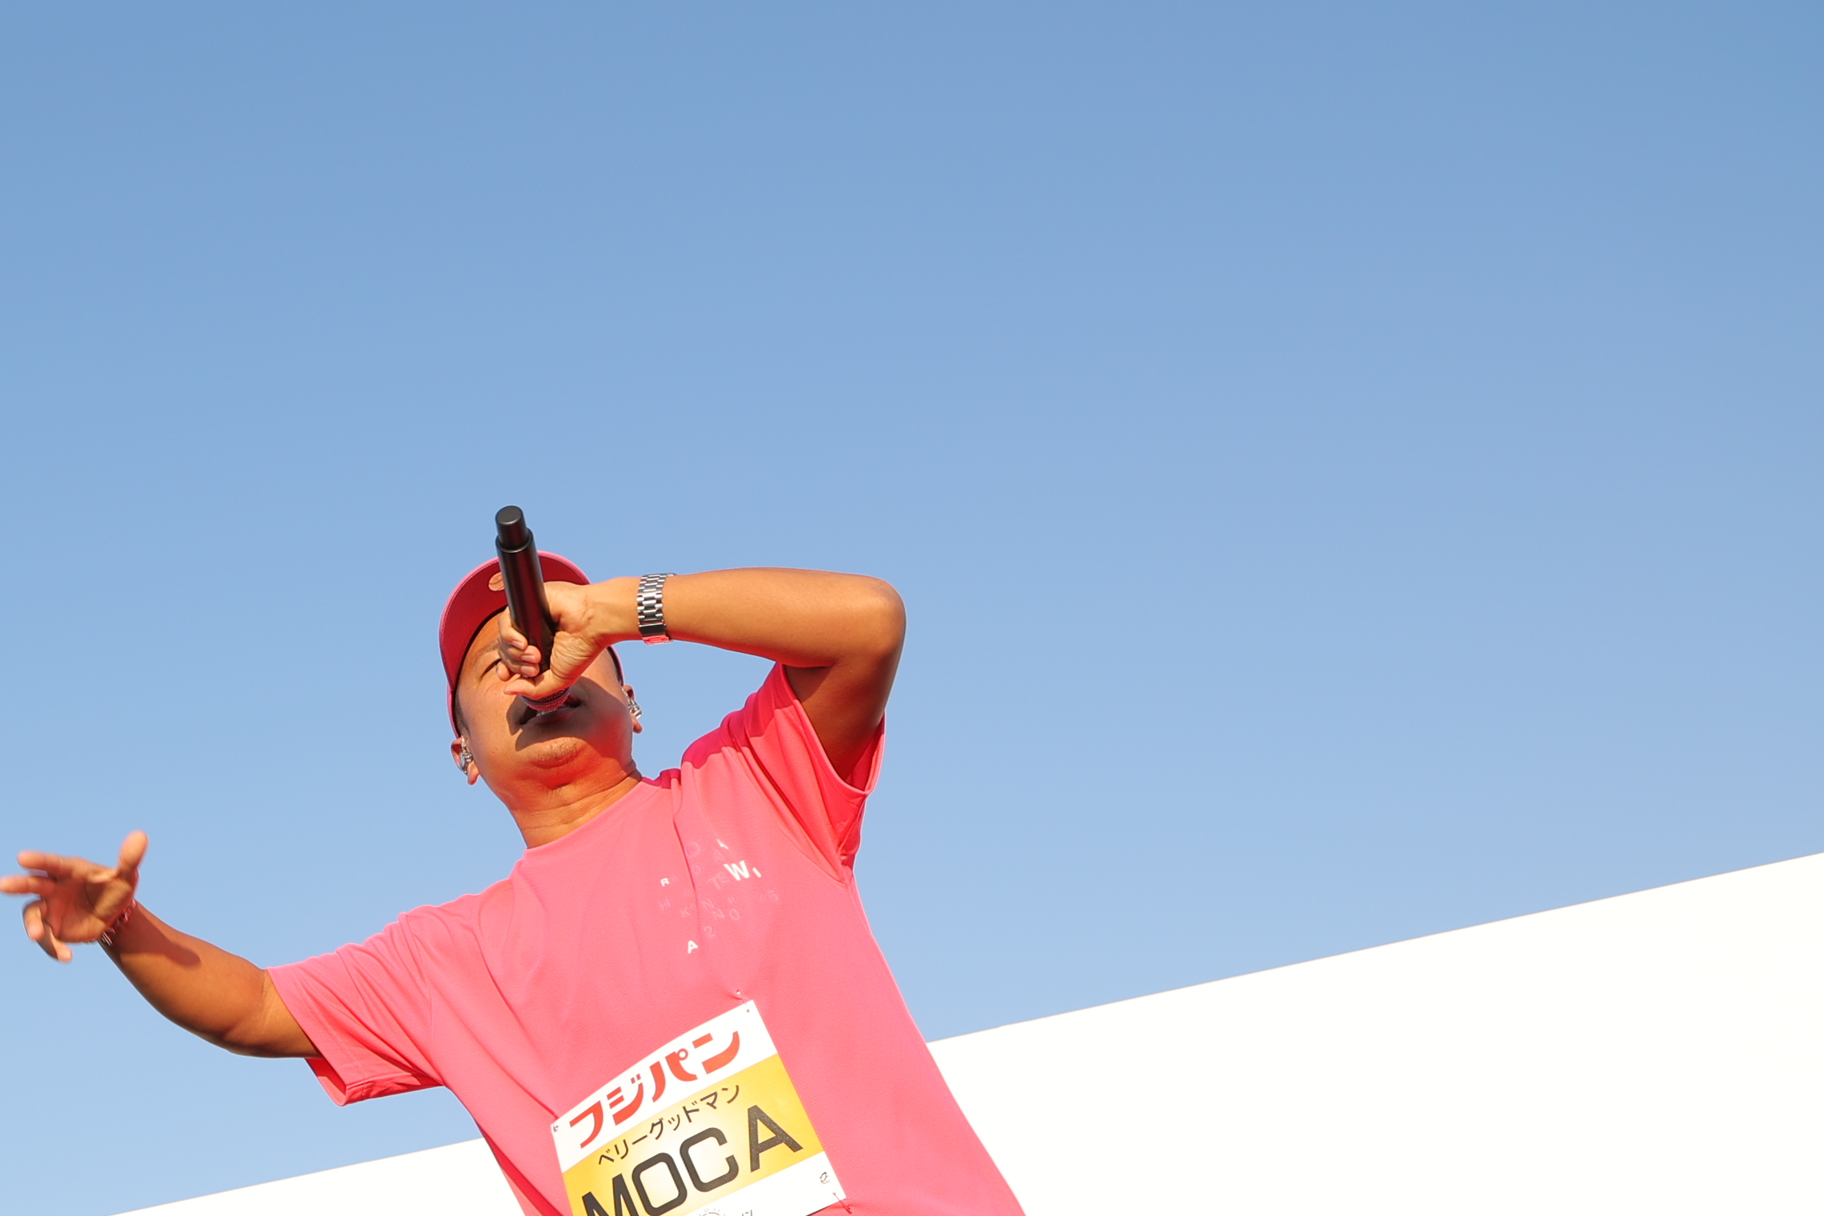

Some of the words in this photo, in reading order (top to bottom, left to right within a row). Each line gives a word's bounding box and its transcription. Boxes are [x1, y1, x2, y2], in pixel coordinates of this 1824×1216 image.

[569, 1031, 740, 1149] フジパン
[598, 1084, 740, 1165] ベリーグッドマン
